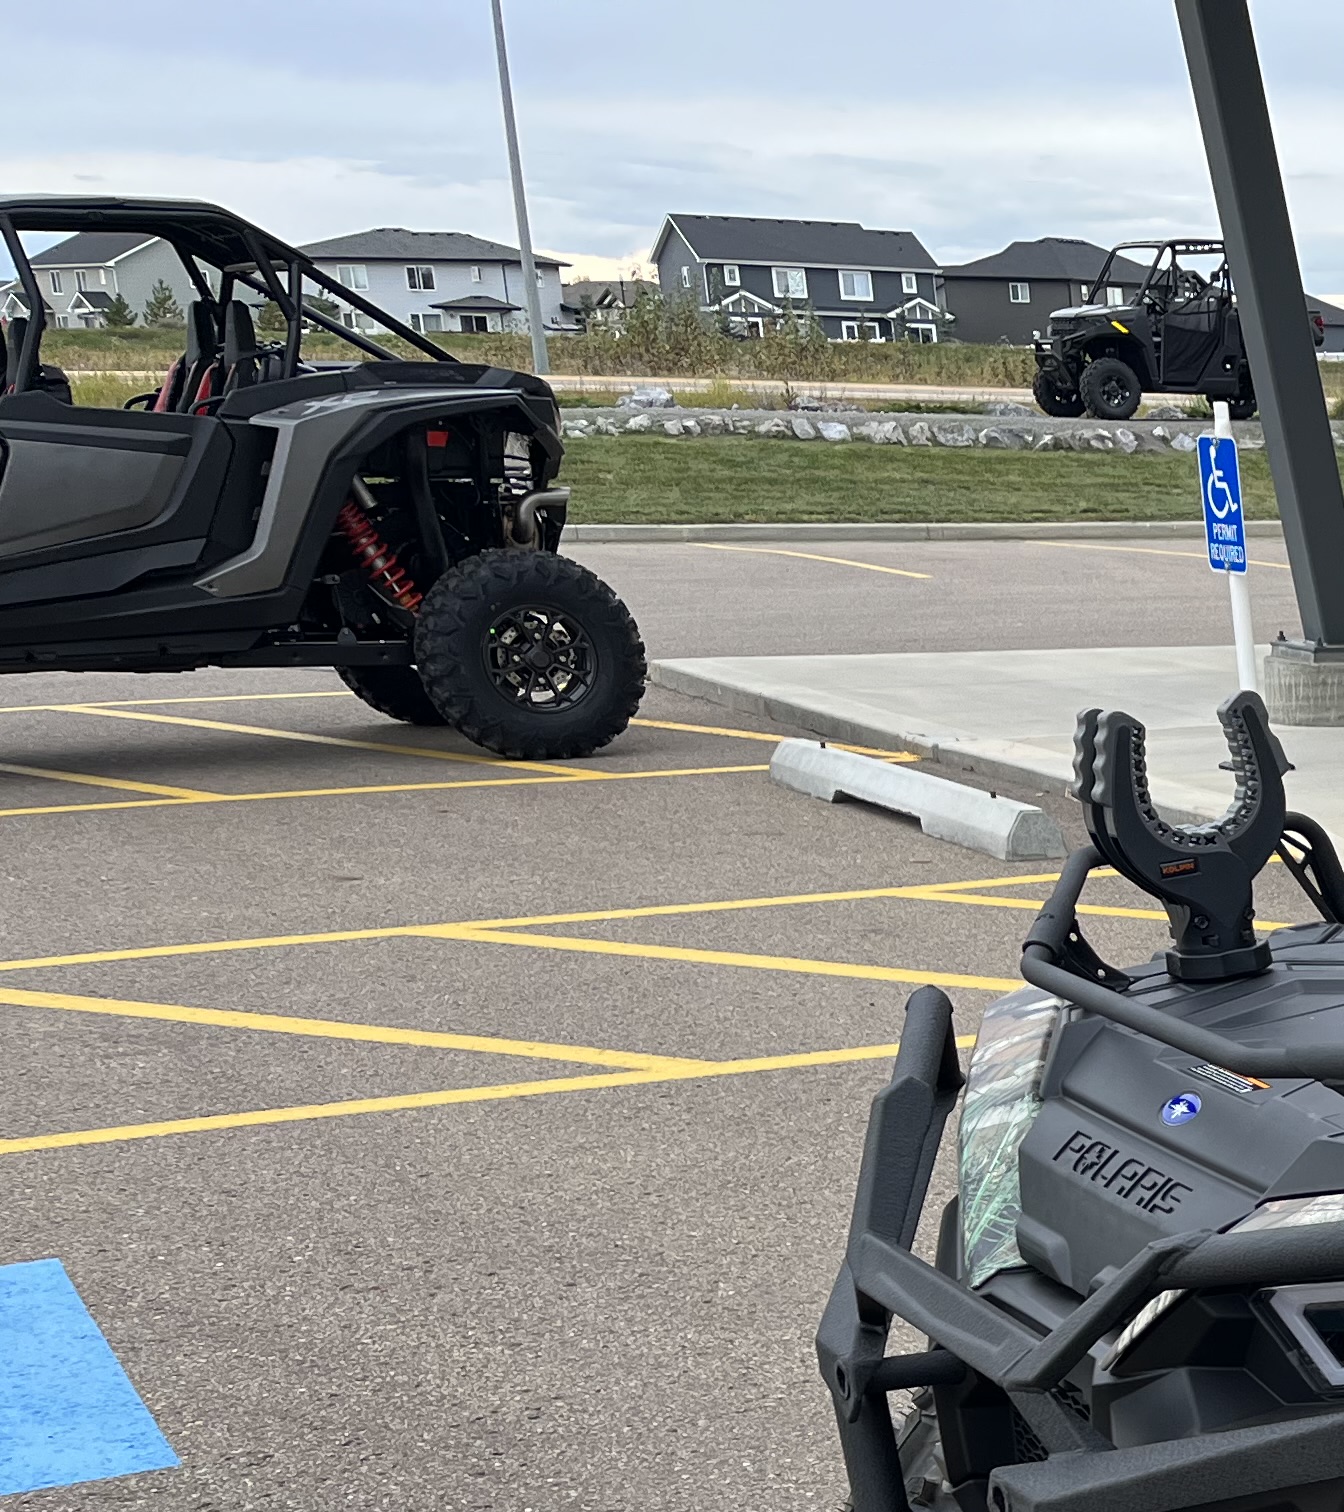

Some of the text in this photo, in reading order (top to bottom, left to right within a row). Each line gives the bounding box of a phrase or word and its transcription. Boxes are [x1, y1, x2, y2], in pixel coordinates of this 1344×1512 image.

[1212, 522, 1238, 542] PERMIT
[1210, 543, 1245, 563] REQUIRED
[1052, 1130, 1194, 1217] POLARIS
